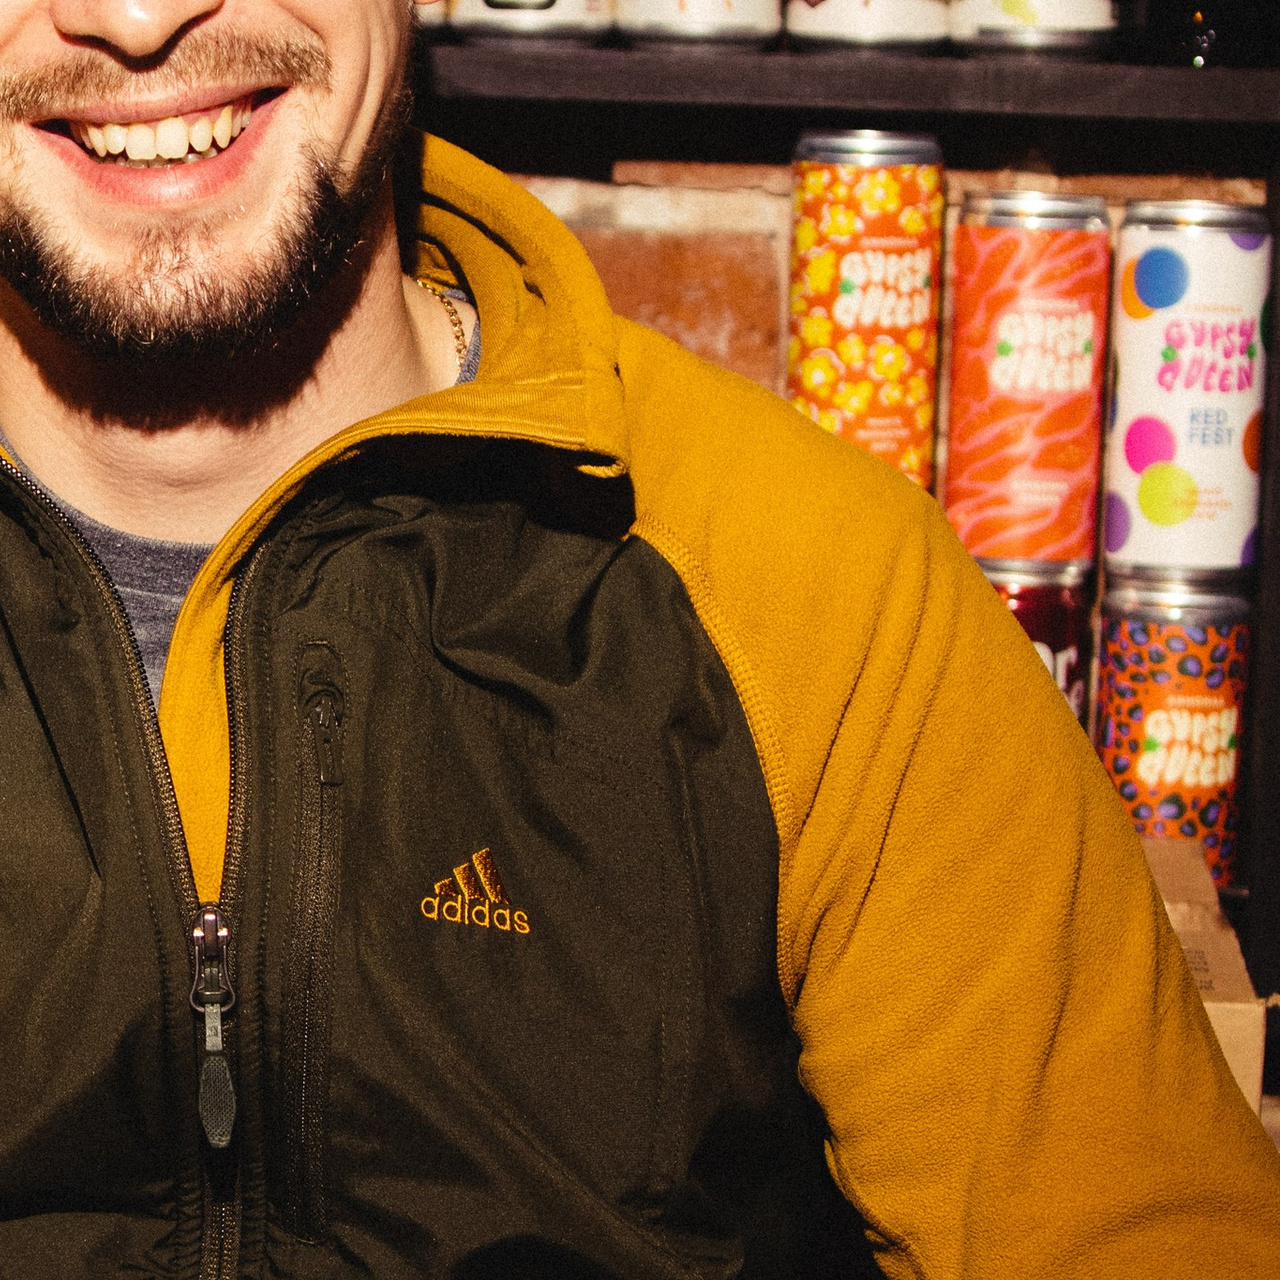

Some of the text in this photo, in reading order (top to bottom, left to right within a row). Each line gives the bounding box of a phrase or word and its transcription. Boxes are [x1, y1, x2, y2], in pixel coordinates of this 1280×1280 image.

[1164, 317, 1256, 360] GYPSY
[1157, 356, 1254, 393] QUEEN
[1189, 408, 1228, 426] RED
[1188, 427, 1236, 447] FEST
[420, 893, 532, 934] adidas
